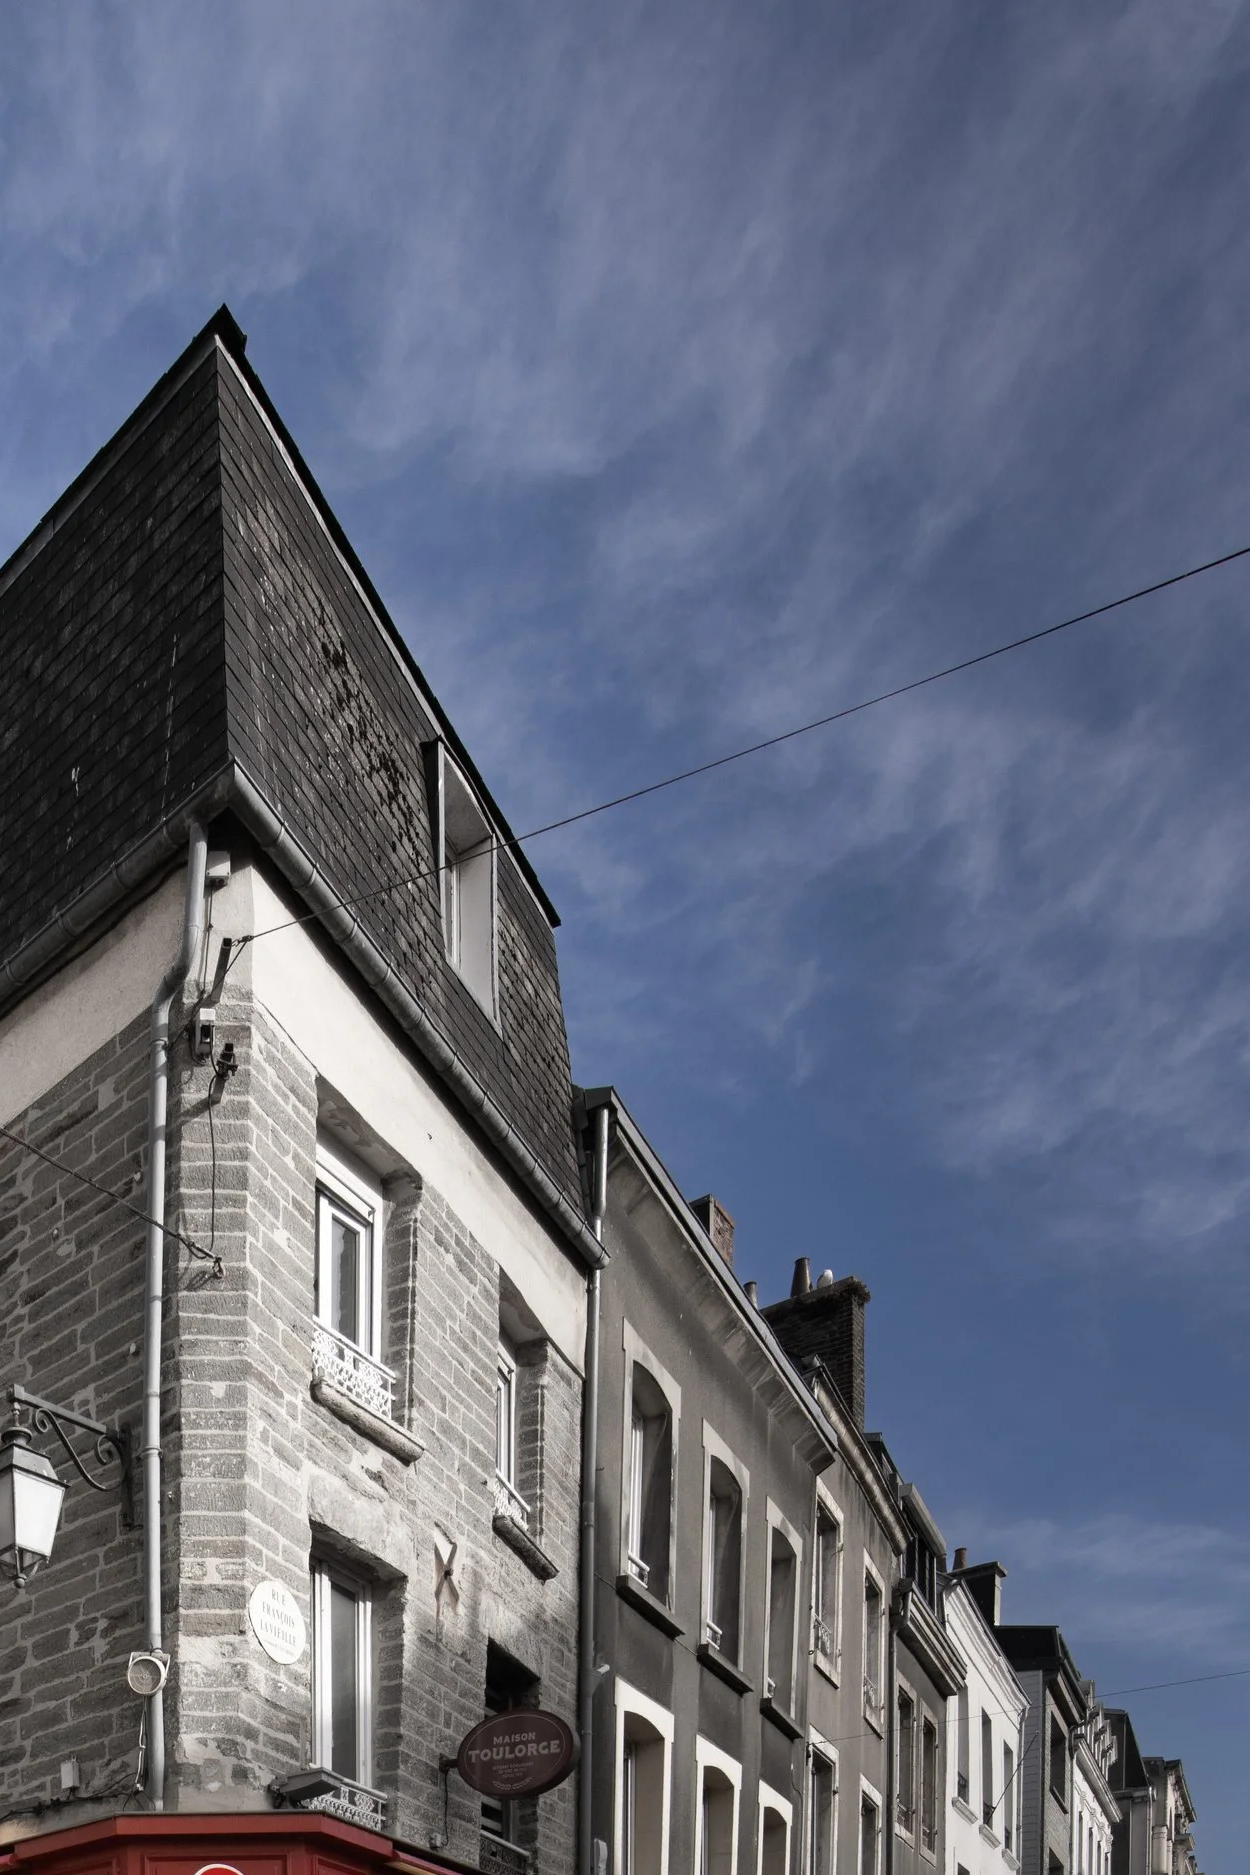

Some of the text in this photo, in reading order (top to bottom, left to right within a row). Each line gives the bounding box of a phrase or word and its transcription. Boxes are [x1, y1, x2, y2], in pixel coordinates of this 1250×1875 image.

[271, 1588, 286, 1606] RUE
[493, 1731, 537, 1746] MAISON
[468, 1740, 561, 1764] TOULORGE
